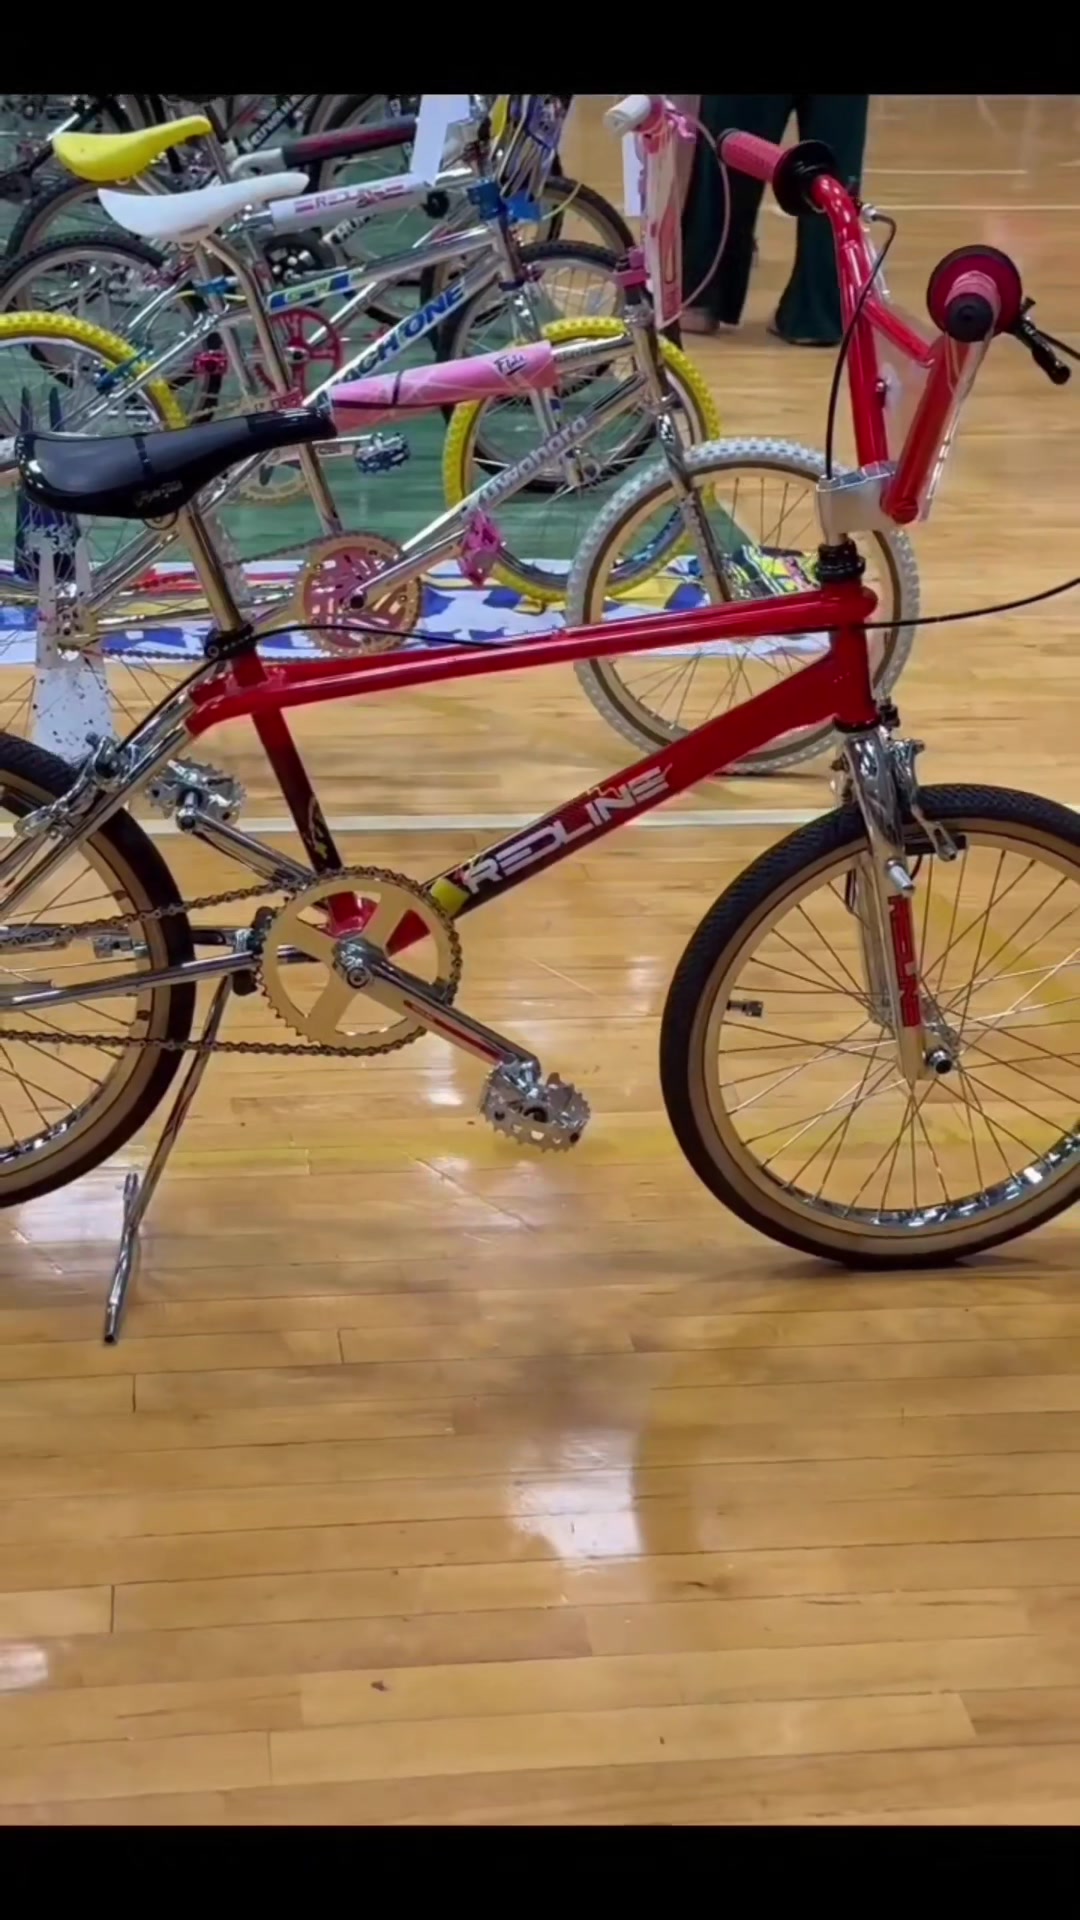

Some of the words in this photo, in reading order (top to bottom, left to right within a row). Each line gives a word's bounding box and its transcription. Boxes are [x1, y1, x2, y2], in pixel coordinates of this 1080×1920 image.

[404, 279, 464, 338] ONE
[461, 763, 673, 895] REDLINE
[887, 894, 922, 1028] REDLINE
